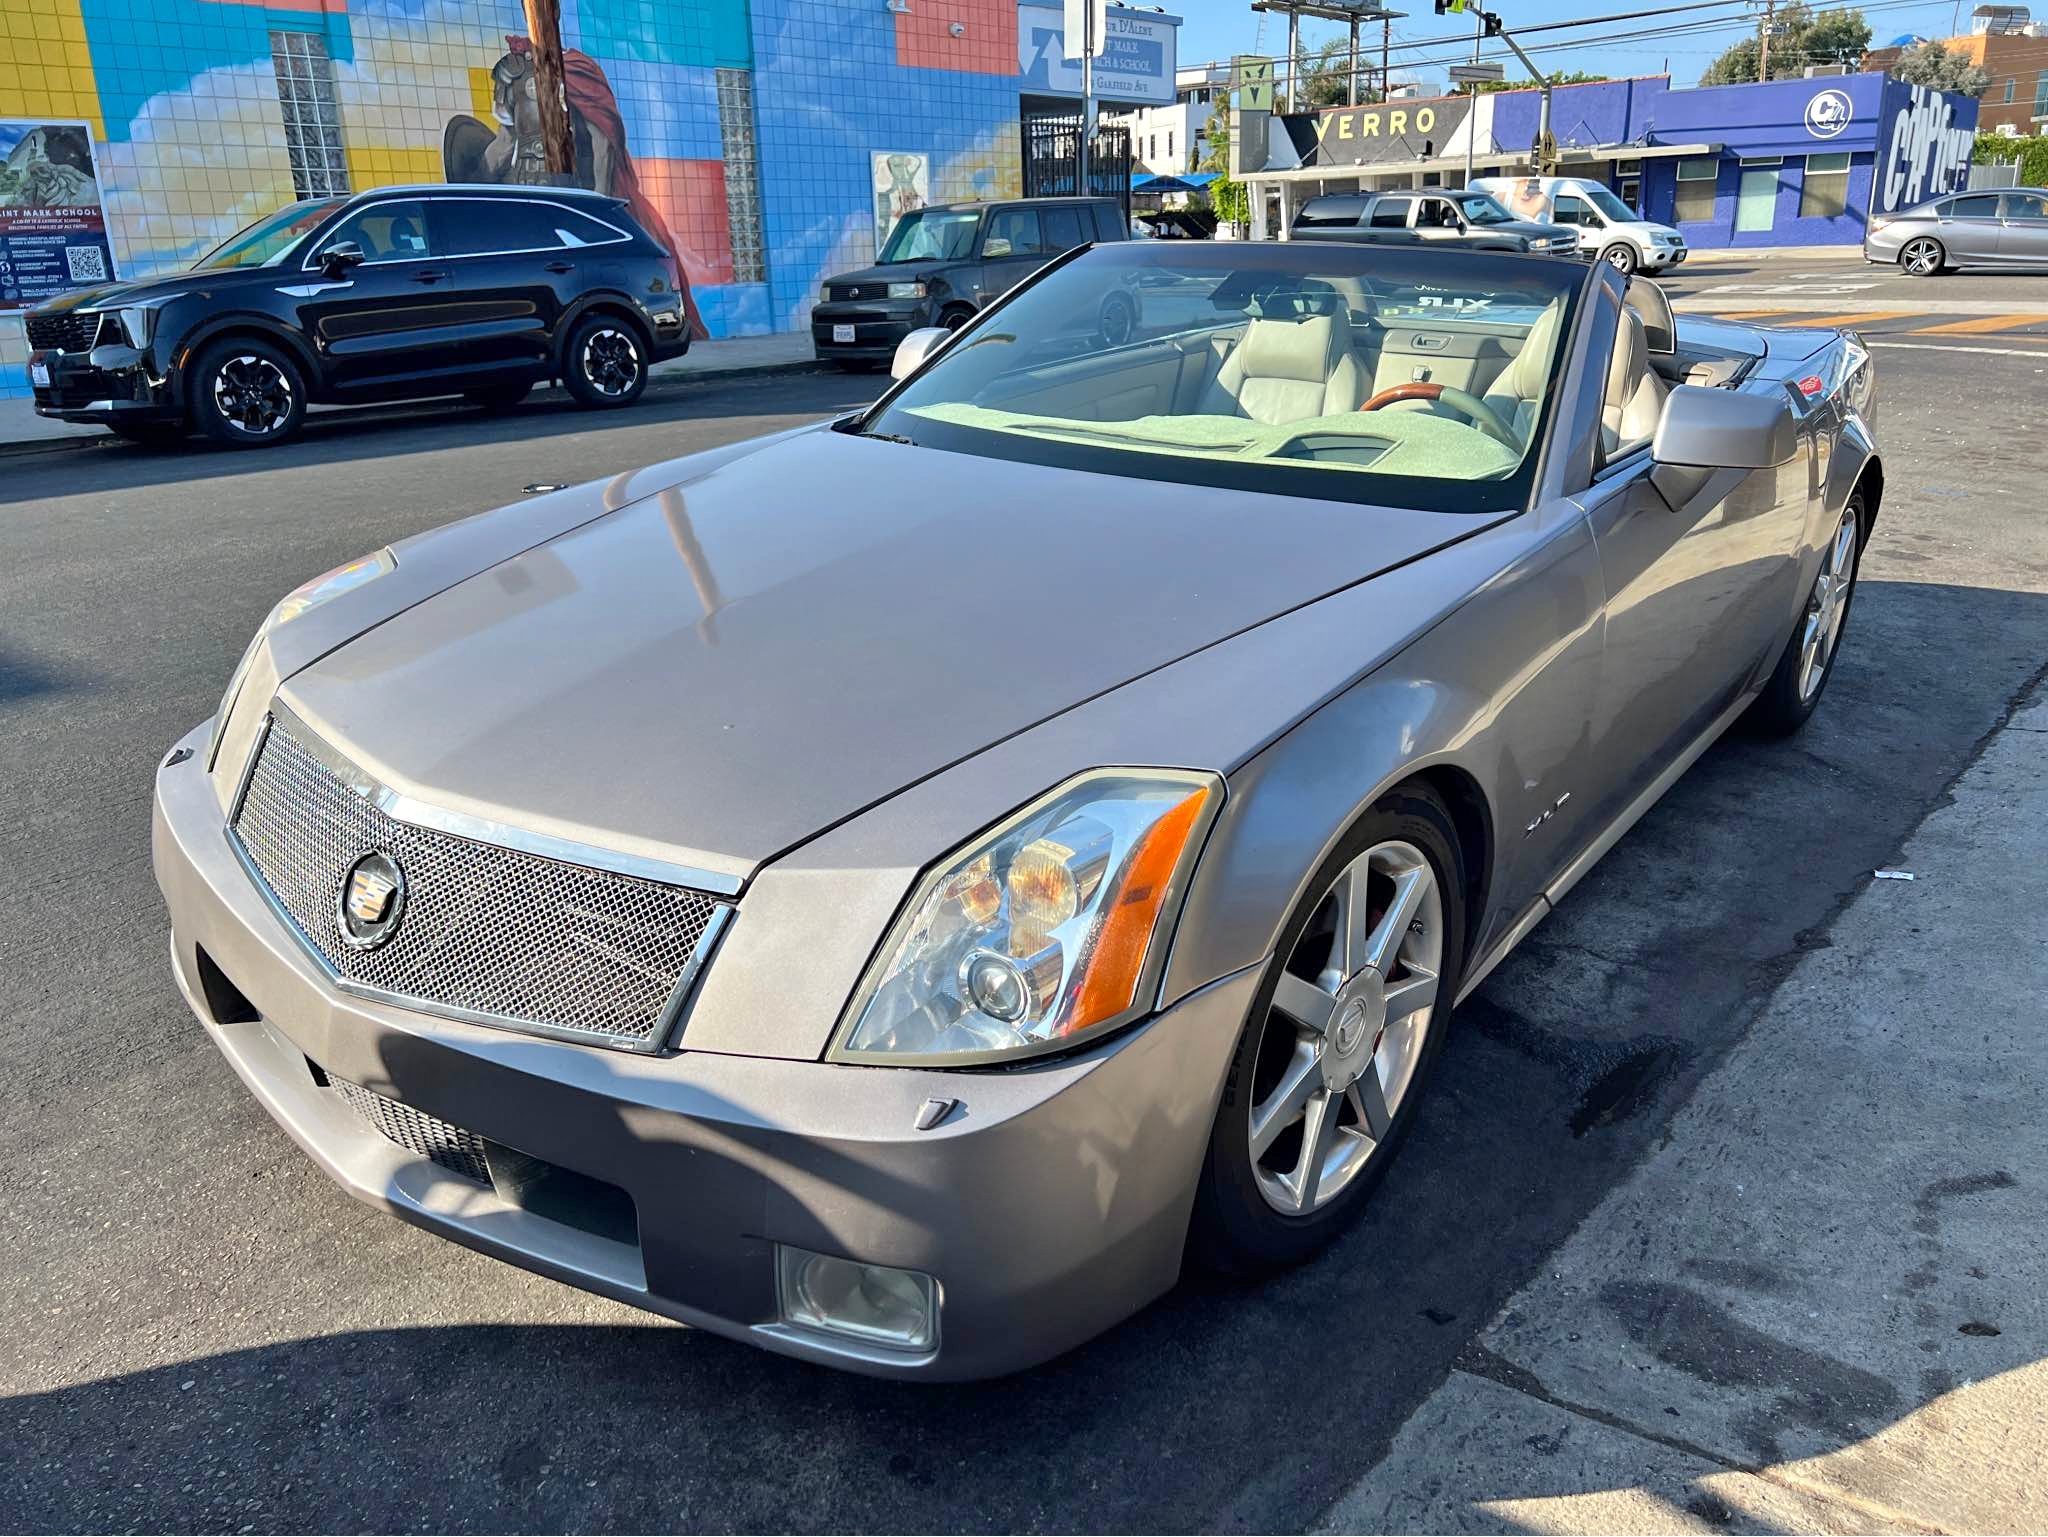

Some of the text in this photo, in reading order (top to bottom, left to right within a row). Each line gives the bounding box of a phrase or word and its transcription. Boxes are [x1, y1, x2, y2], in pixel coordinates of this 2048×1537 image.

[1119, 58, 1152, 72] SCHOOL
[1310, 107, 1435, 142] VERRO
[23, 209, 52, 217] MARK
[55, 208, 97, 217] SCHOOL
